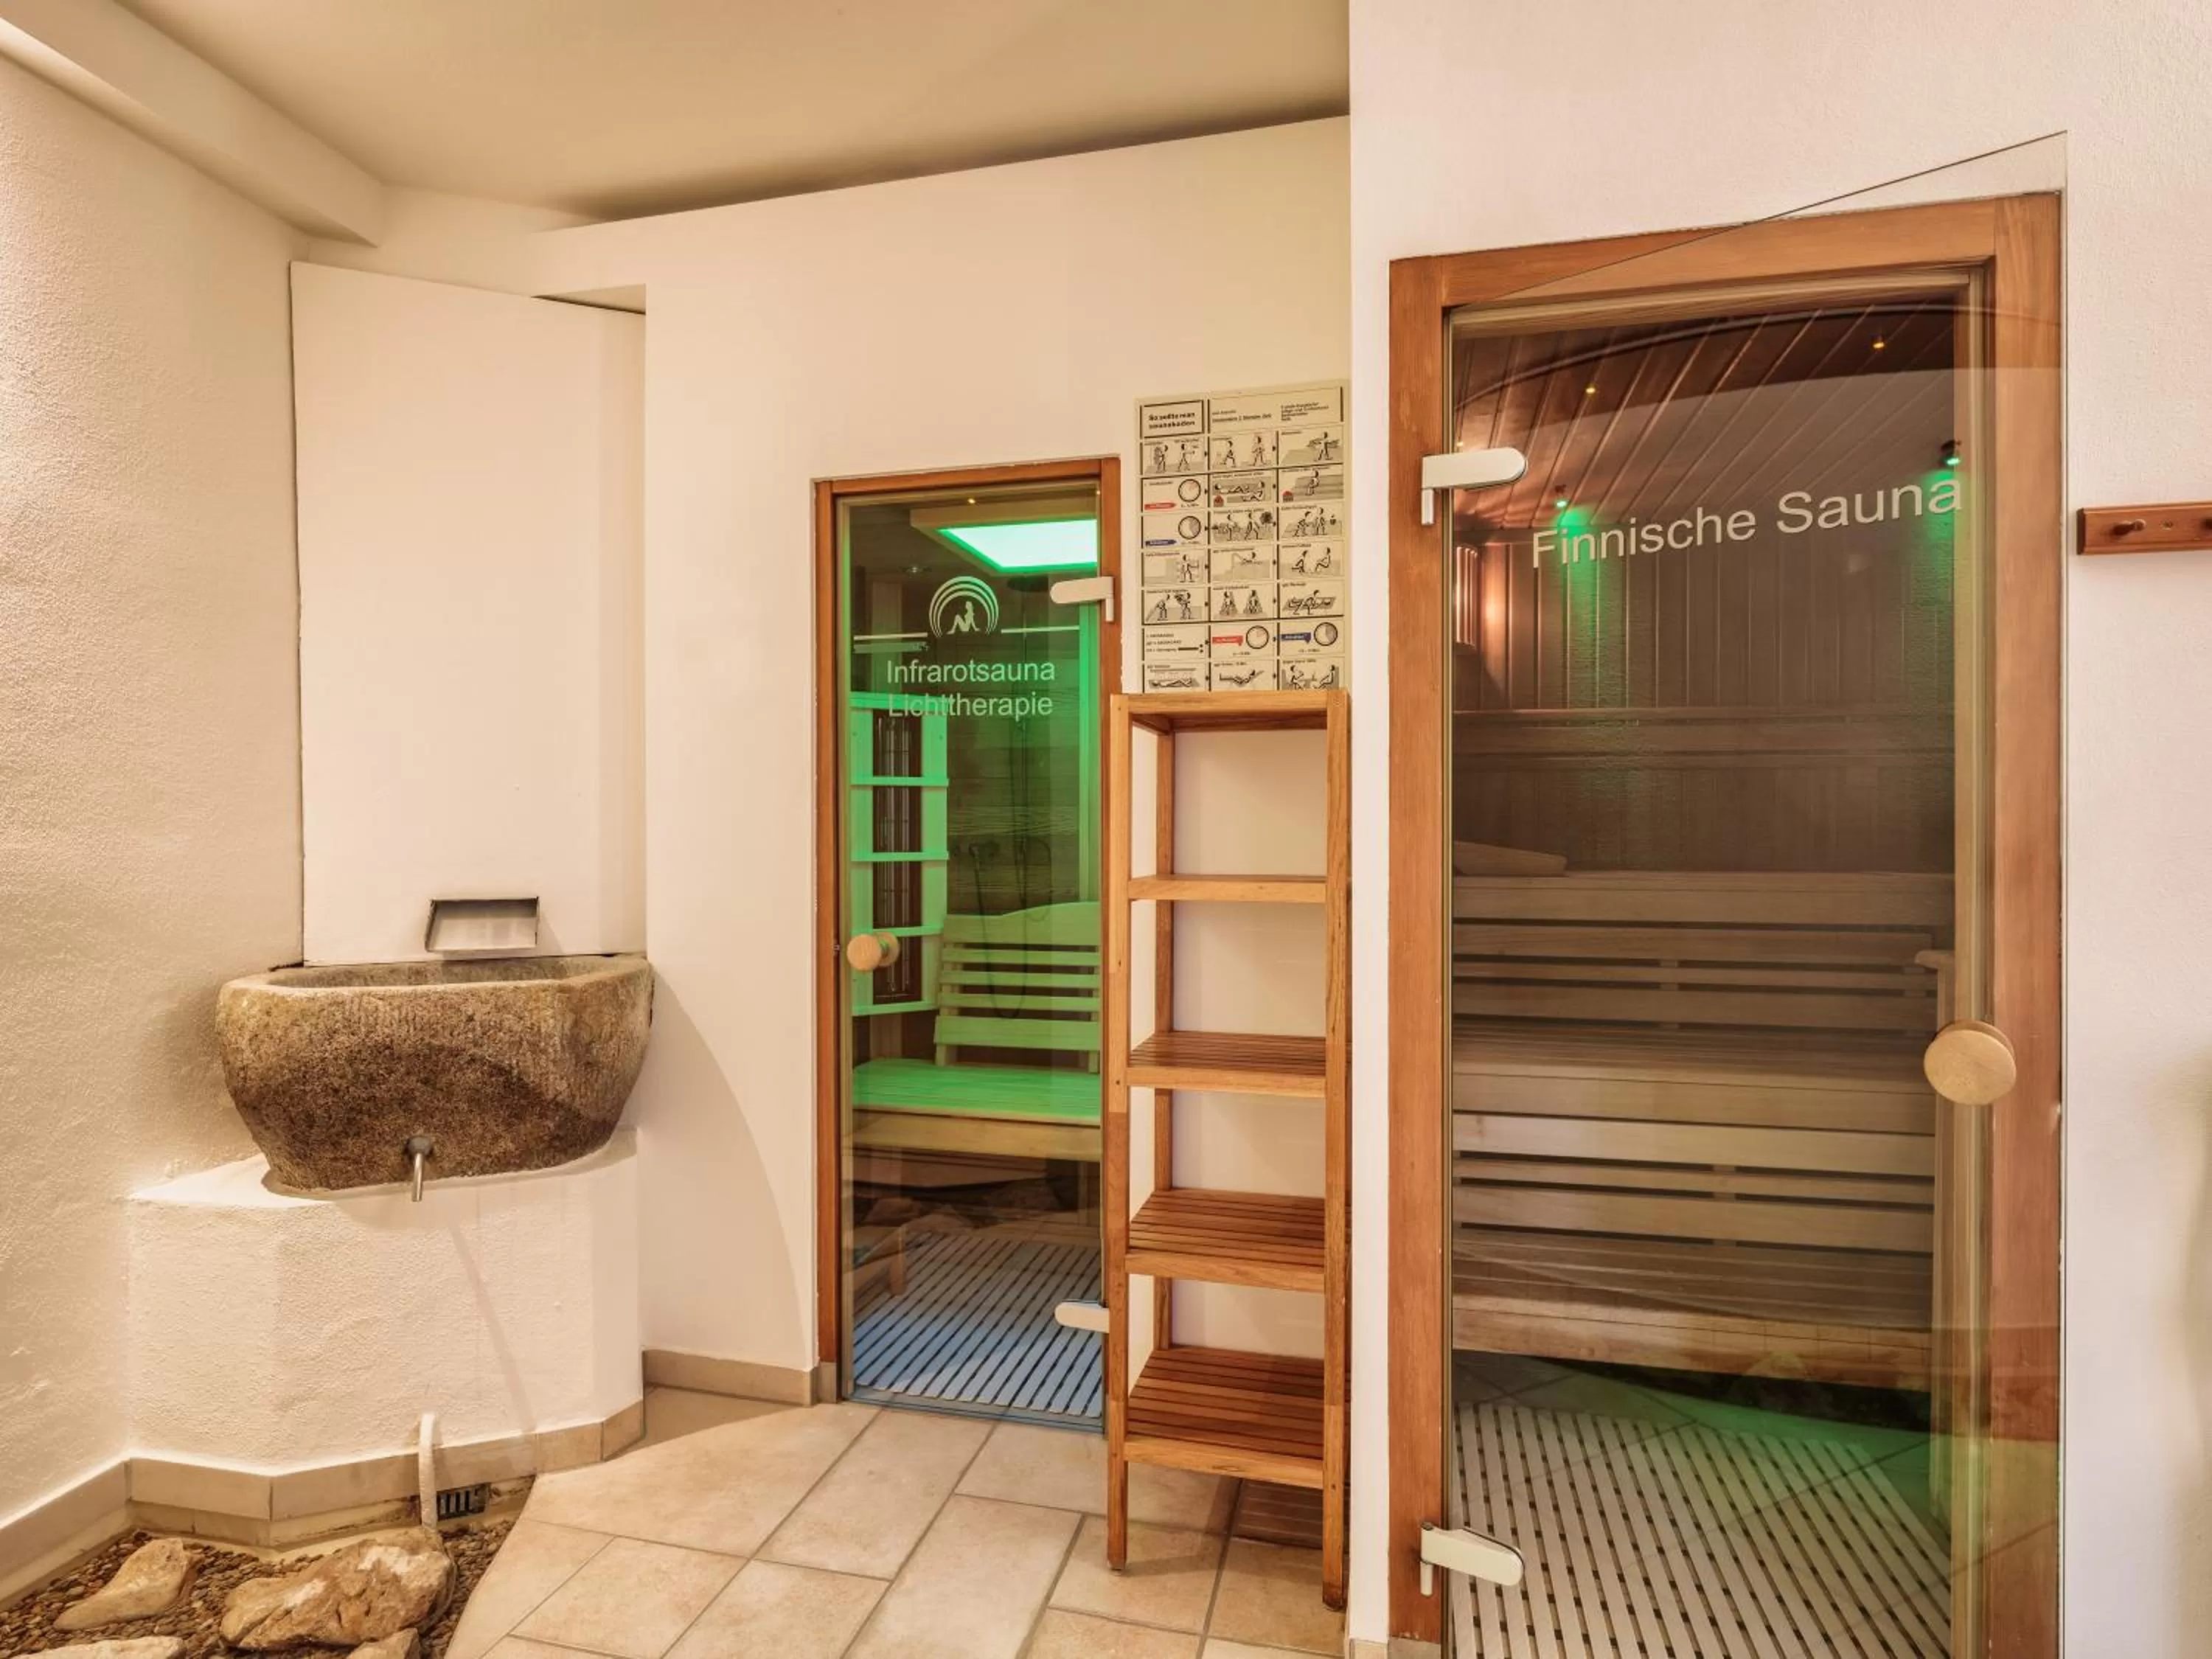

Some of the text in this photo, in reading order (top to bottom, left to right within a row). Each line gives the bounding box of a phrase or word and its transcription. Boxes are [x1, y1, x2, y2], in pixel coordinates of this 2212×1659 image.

[1533, 478, 1963, 569] Finnische Sauna
[887, 659, 1055, 684] Infrarotsauna
[888, 691, 1053, 721] Lichttherapie
